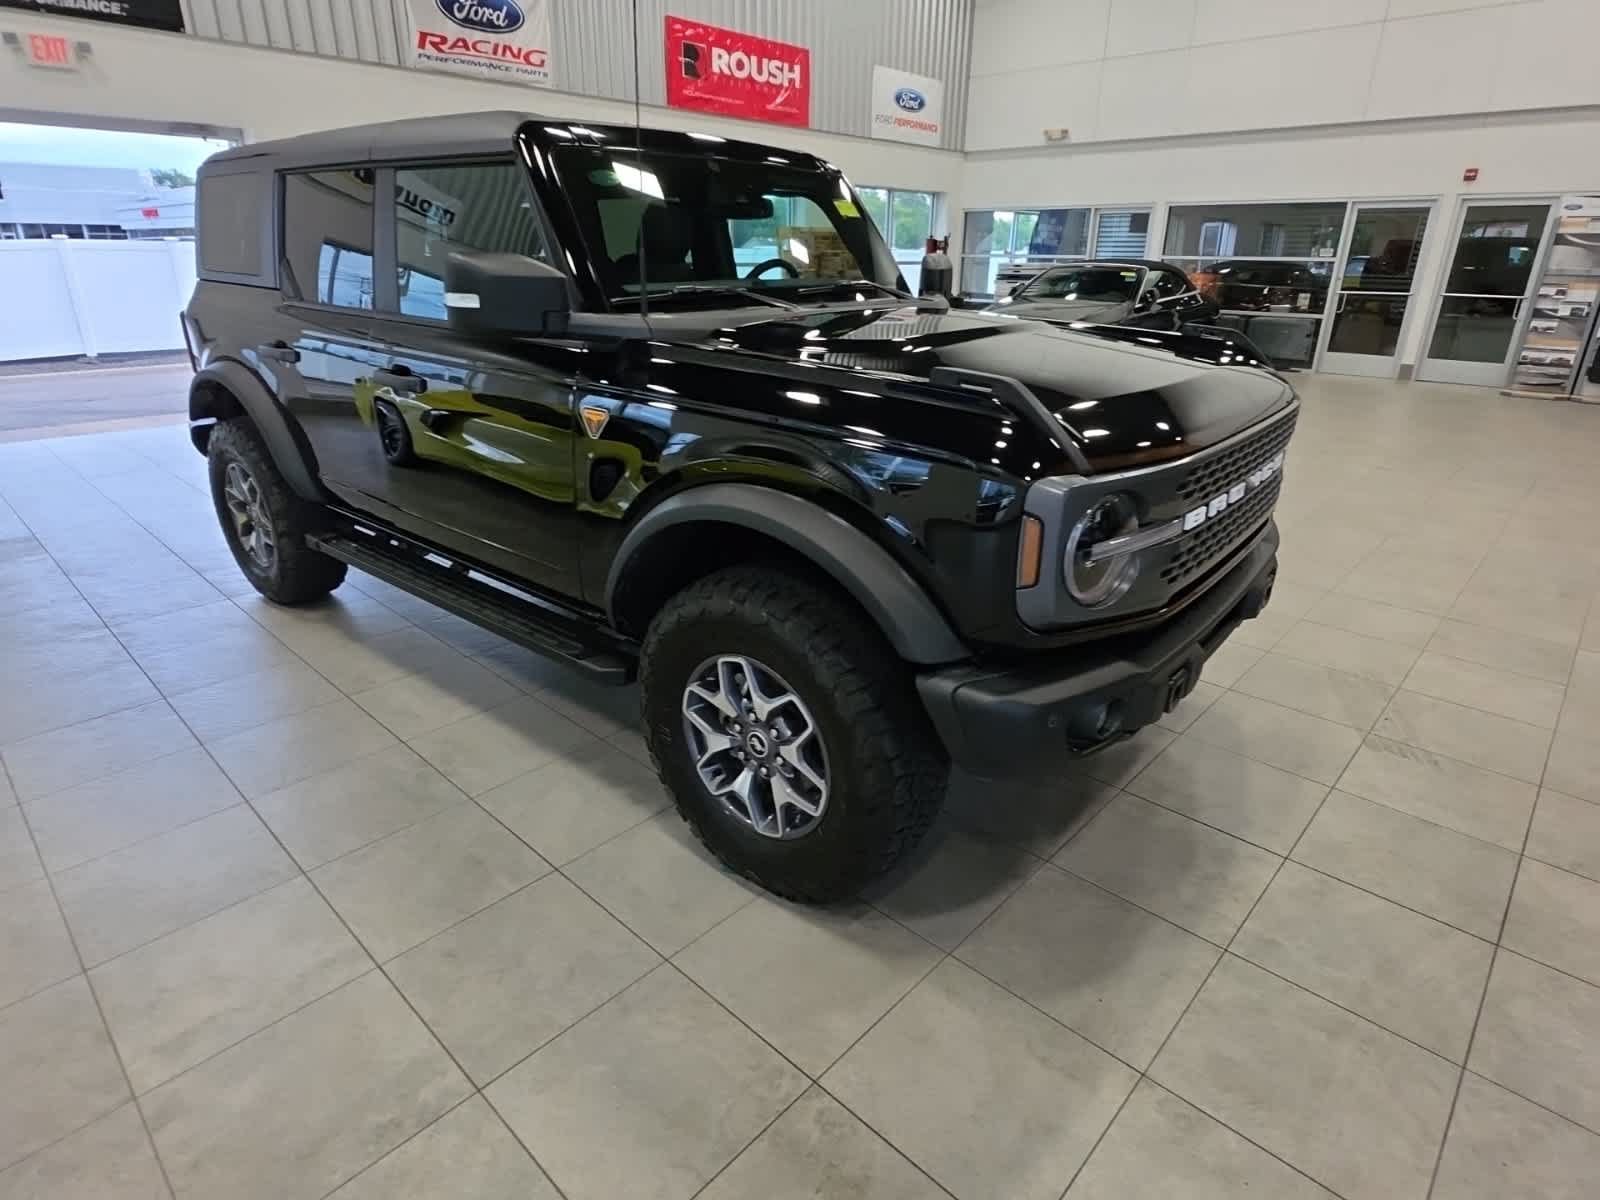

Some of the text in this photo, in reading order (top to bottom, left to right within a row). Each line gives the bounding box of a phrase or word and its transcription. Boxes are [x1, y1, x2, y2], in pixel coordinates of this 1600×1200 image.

[453, 0, 508, 27] Ford
[29, 34, 68, 64] EXIT
[417, 31, 547, 67] RACING
[417, 53, 549, 78] PERFORMANCE PARTS
[711, 47, 801, 88] ROUSH
[899, 92, 921, 109] Ford
